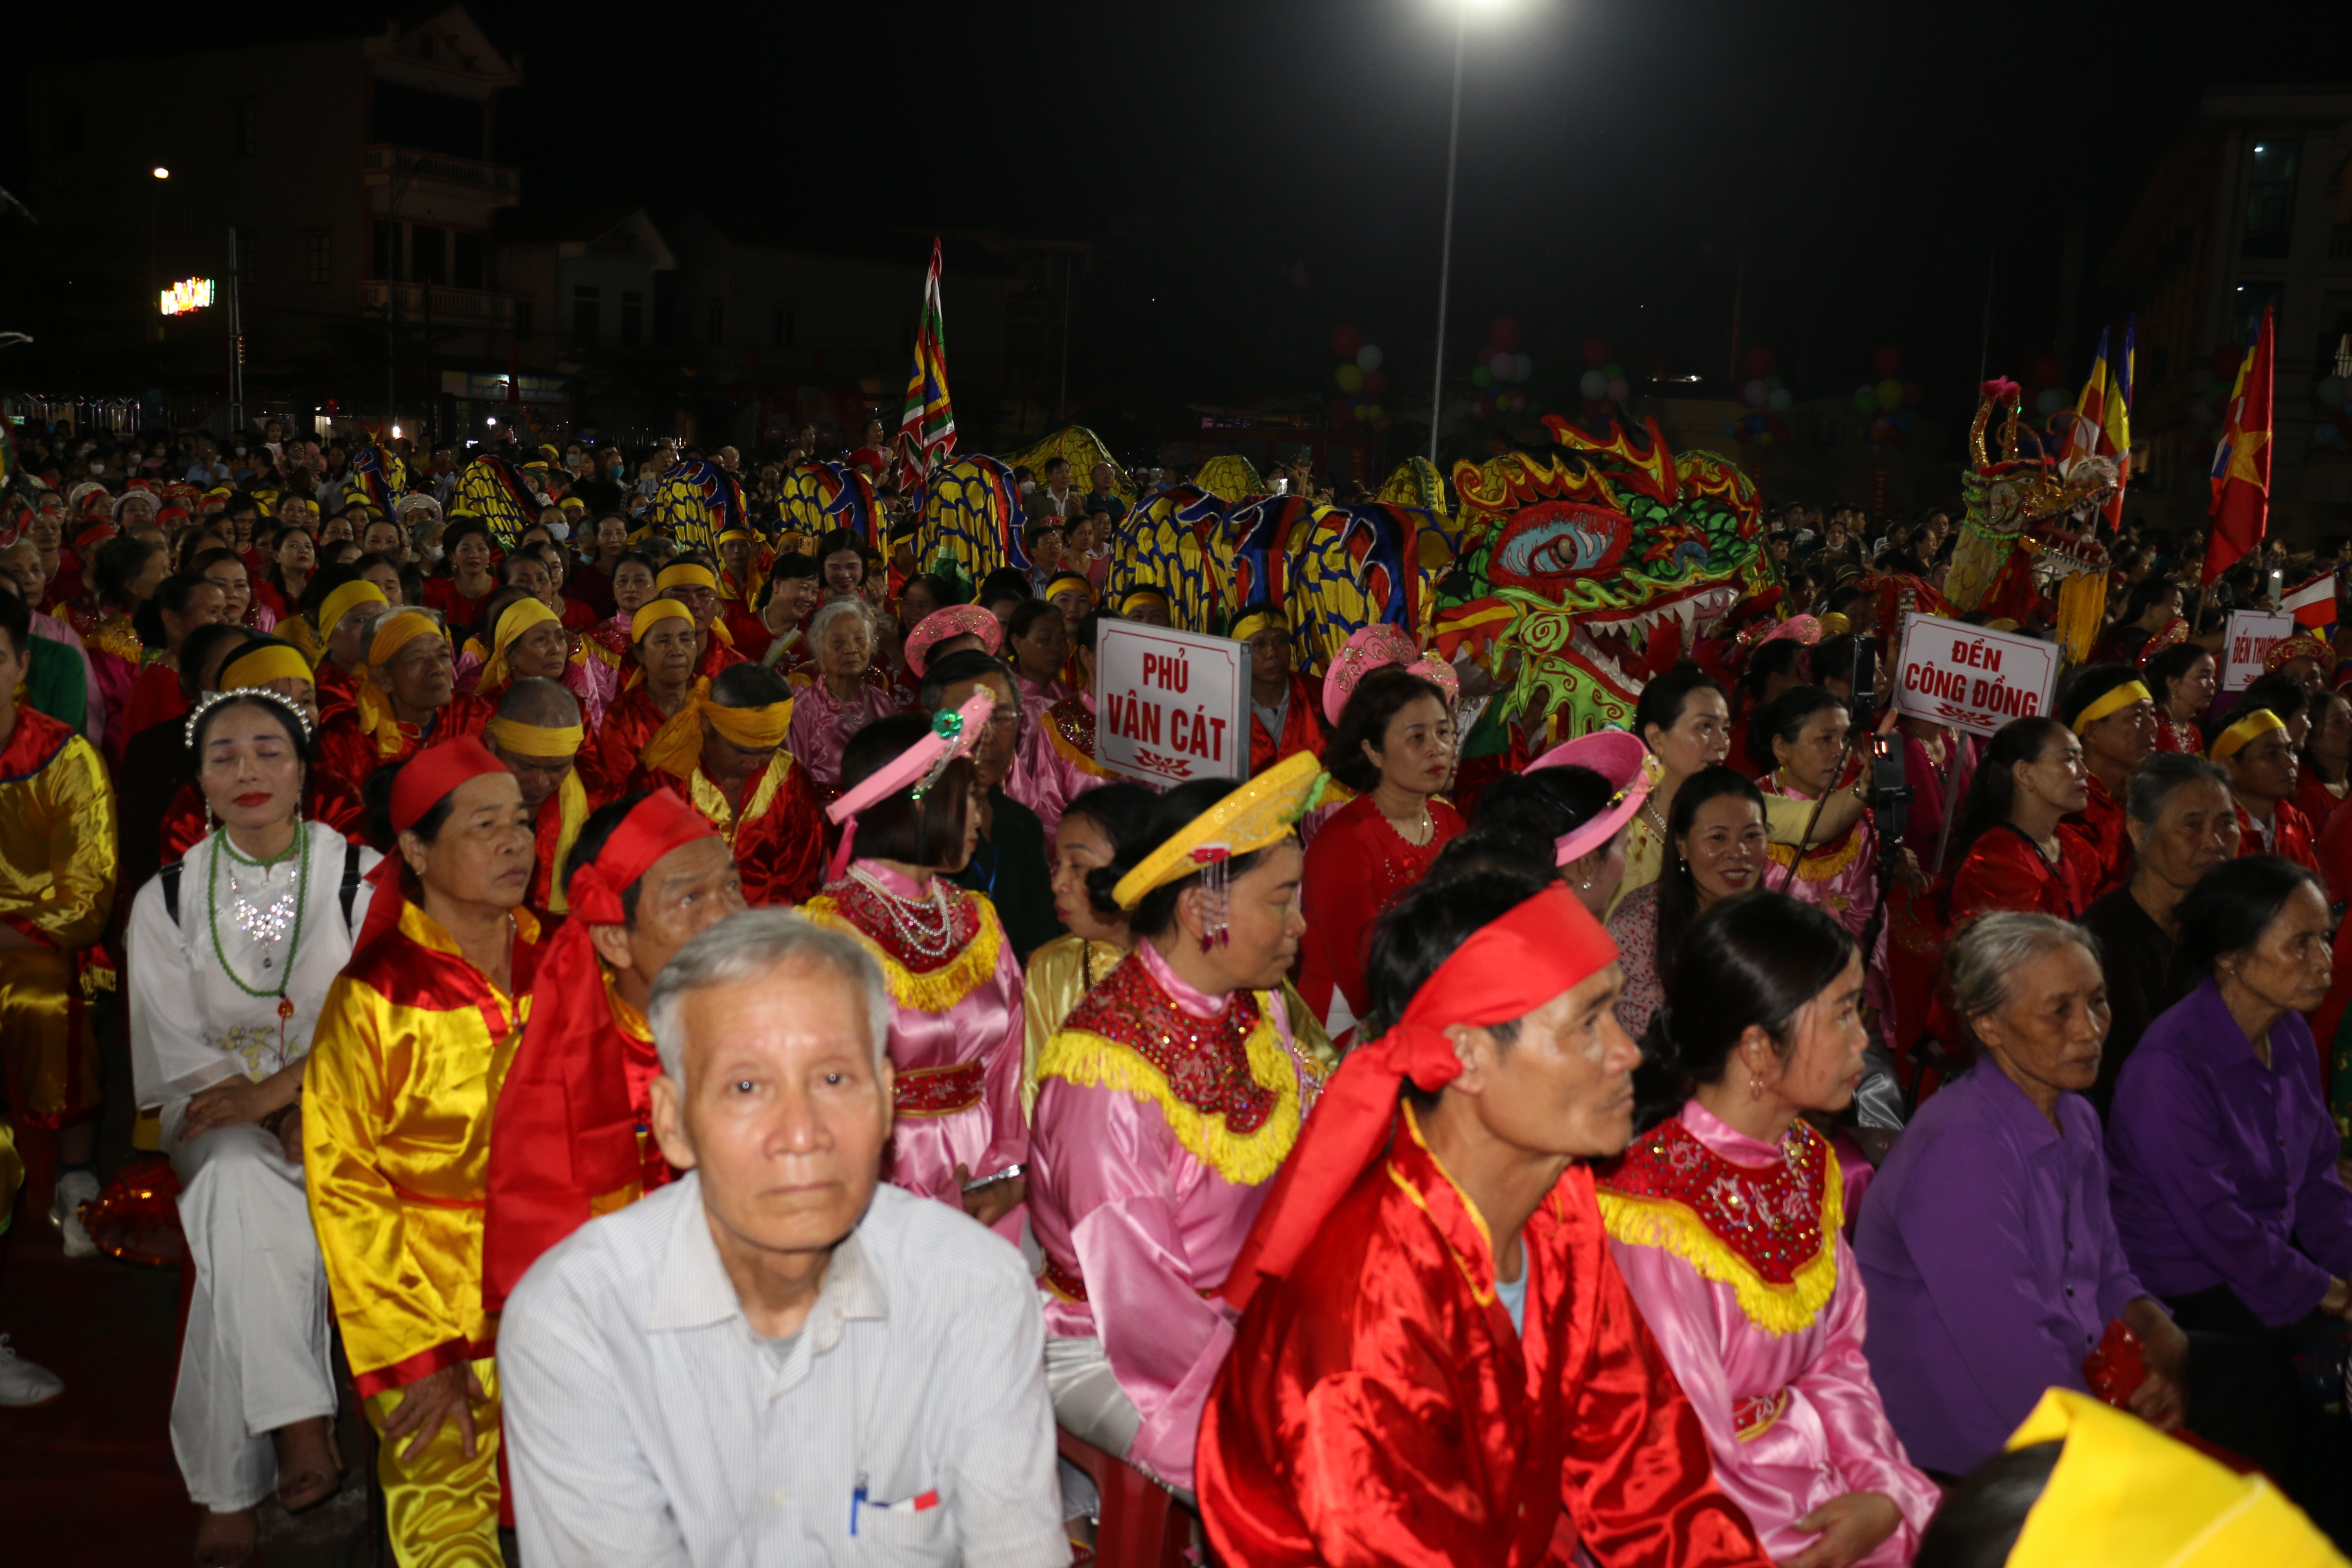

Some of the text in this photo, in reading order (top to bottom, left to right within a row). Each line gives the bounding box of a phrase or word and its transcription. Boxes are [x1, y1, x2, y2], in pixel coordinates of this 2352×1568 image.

[1143, 647, 1188, 694] PHỦ
[1951, 638, 2002, 672] ĐỀN
[1905, 661, 2038, 717] CÔNG ĐỒNG
[1108, 689, 1226, 762] VÂN CÁT
